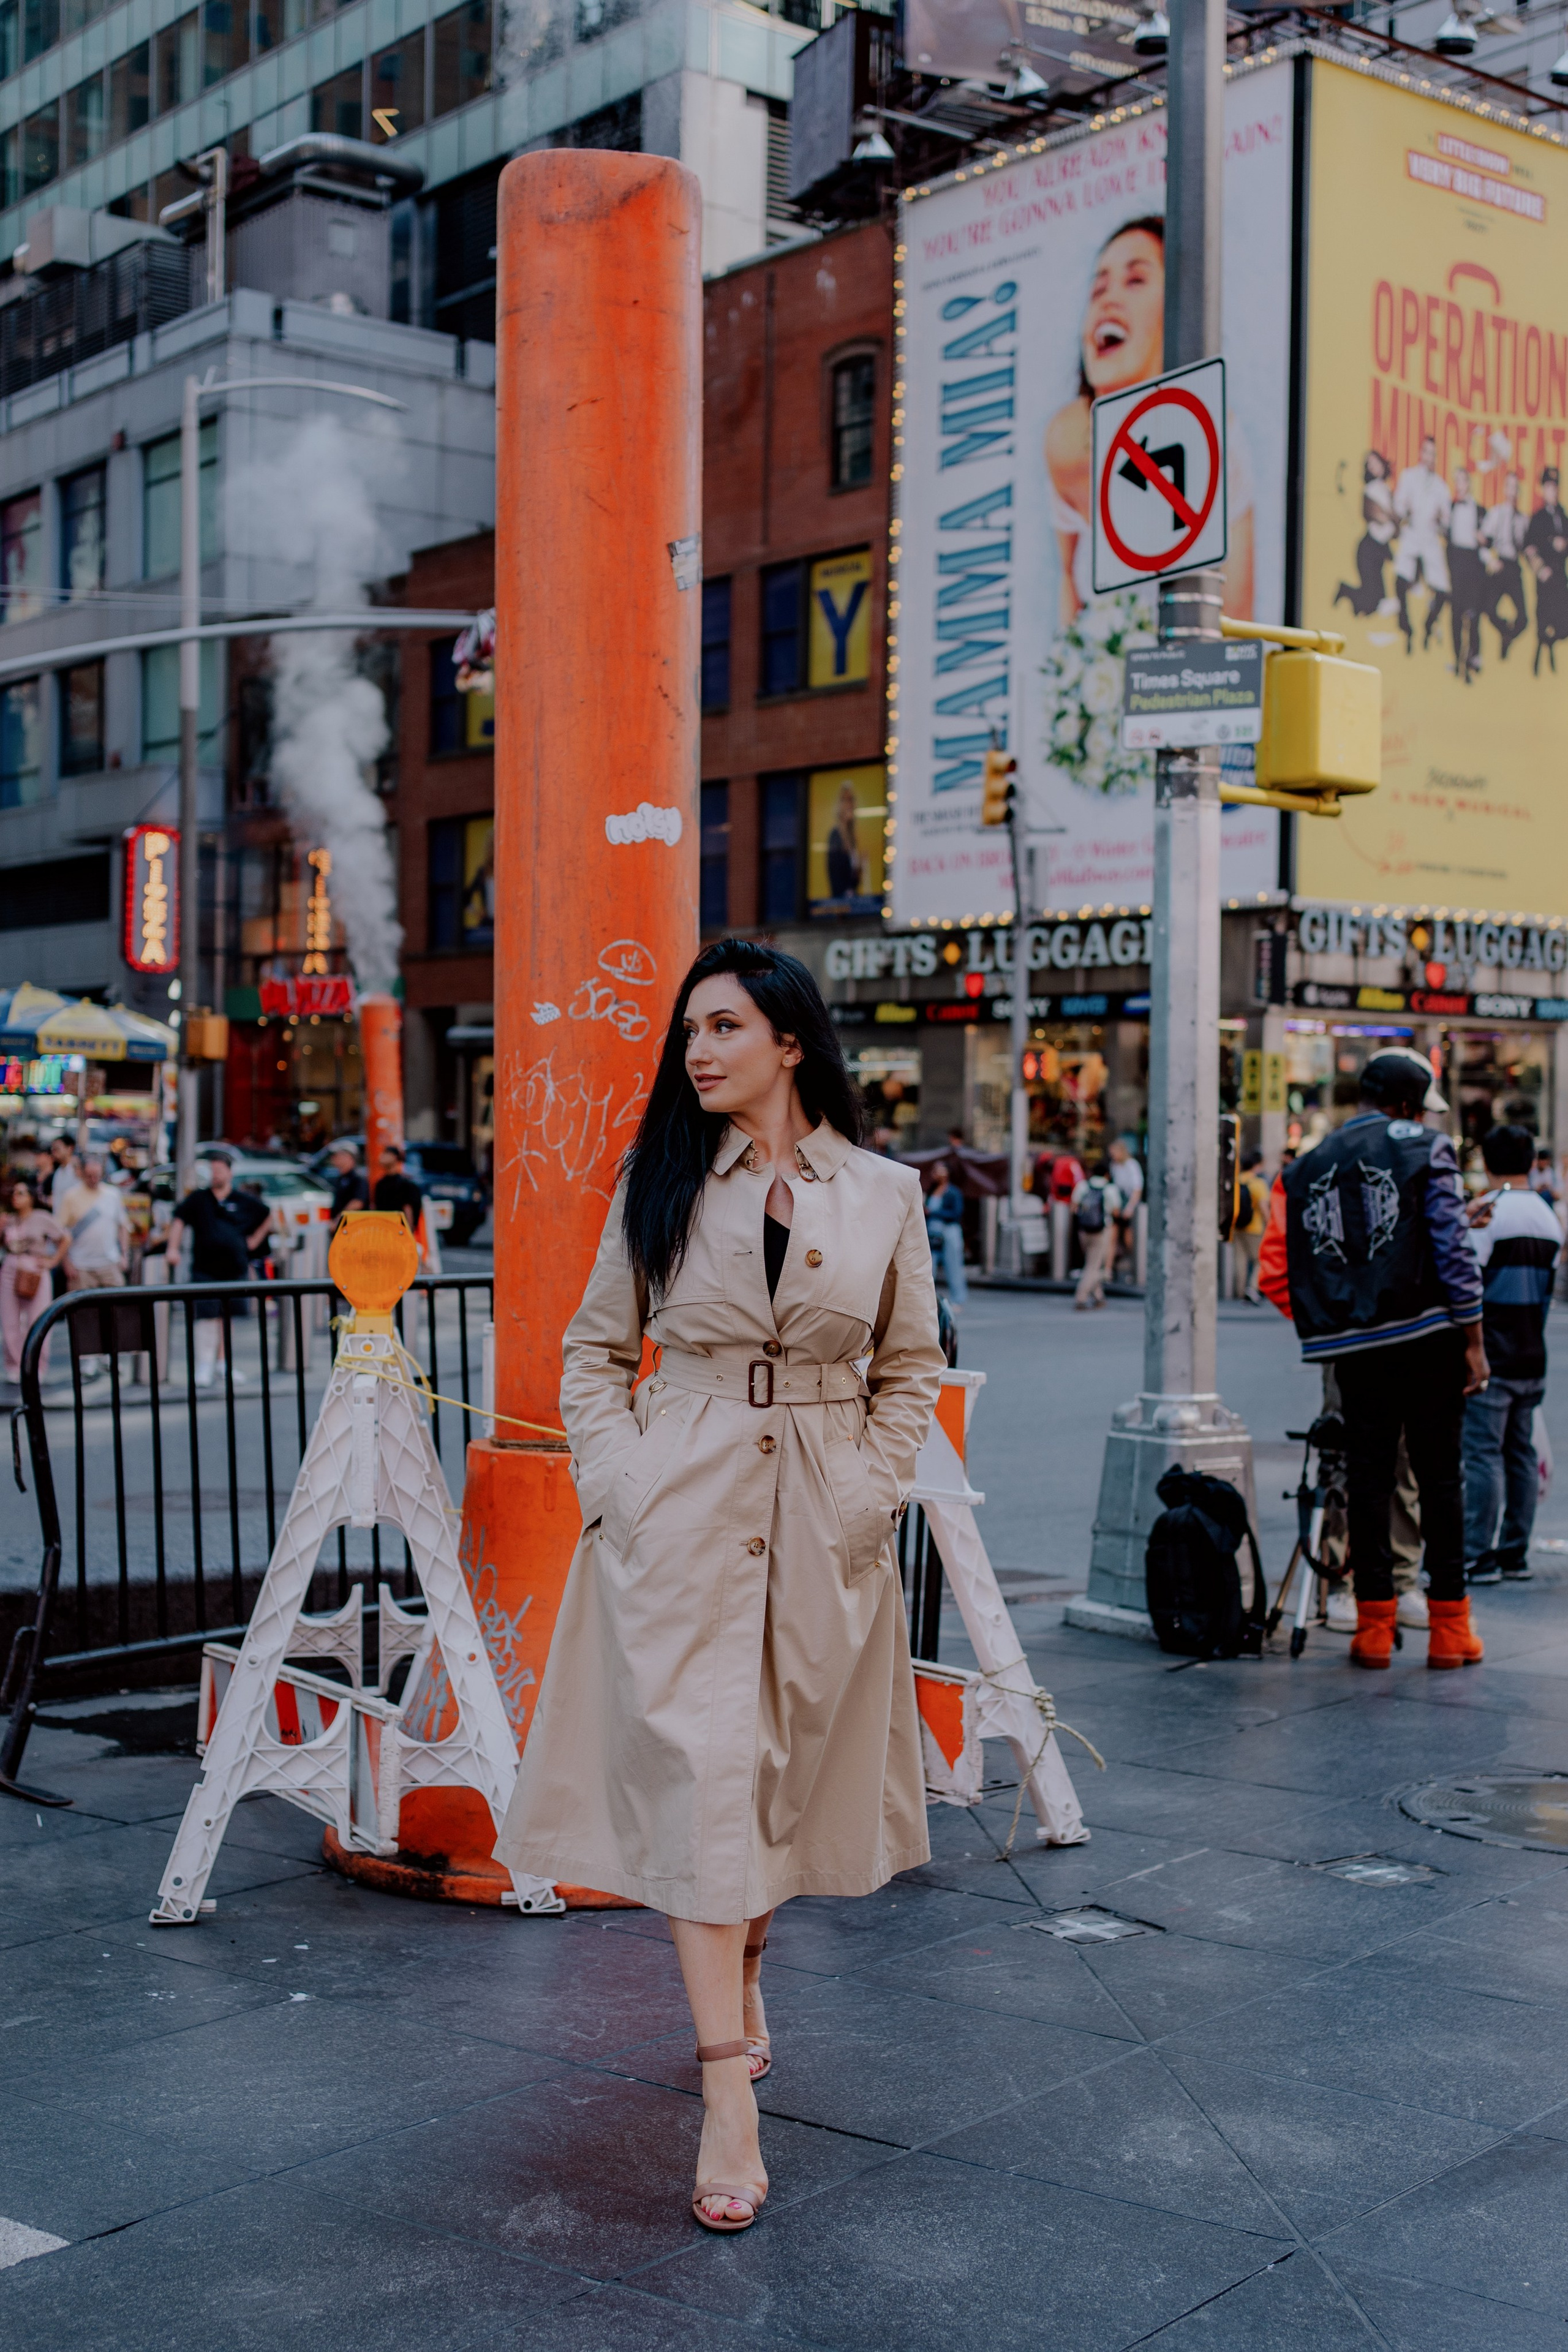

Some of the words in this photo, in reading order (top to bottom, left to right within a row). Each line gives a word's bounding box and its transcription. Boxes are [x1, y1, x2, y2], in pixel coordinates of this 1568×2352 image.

[1034, 138, 1126, 187] ALREADY
[998, 189, 1078, 236] GONNA
[938, 281, 1017, 473] MIA!
[1374, 279, 1568, 419] OPERATION
[816, 580, 870, 676] Y
[932, 481, 1016, 796] MAMMA
[1129, 690, 1211, 710] Pedestrian
[1212, 688, 1255, 705] Plaza
[1130, 671, 1179, 690] Times
[1180, 668, 1241, 690] Square
[141, 831, 170, 966] PIZZA
[825, 935, 937, 980] GIFTS
[1299, 910, 1408, 959] GIFTS
[1433, 920, 1568, 973] LUGGAG
[1474, 993, 1533, 1019] SONY
